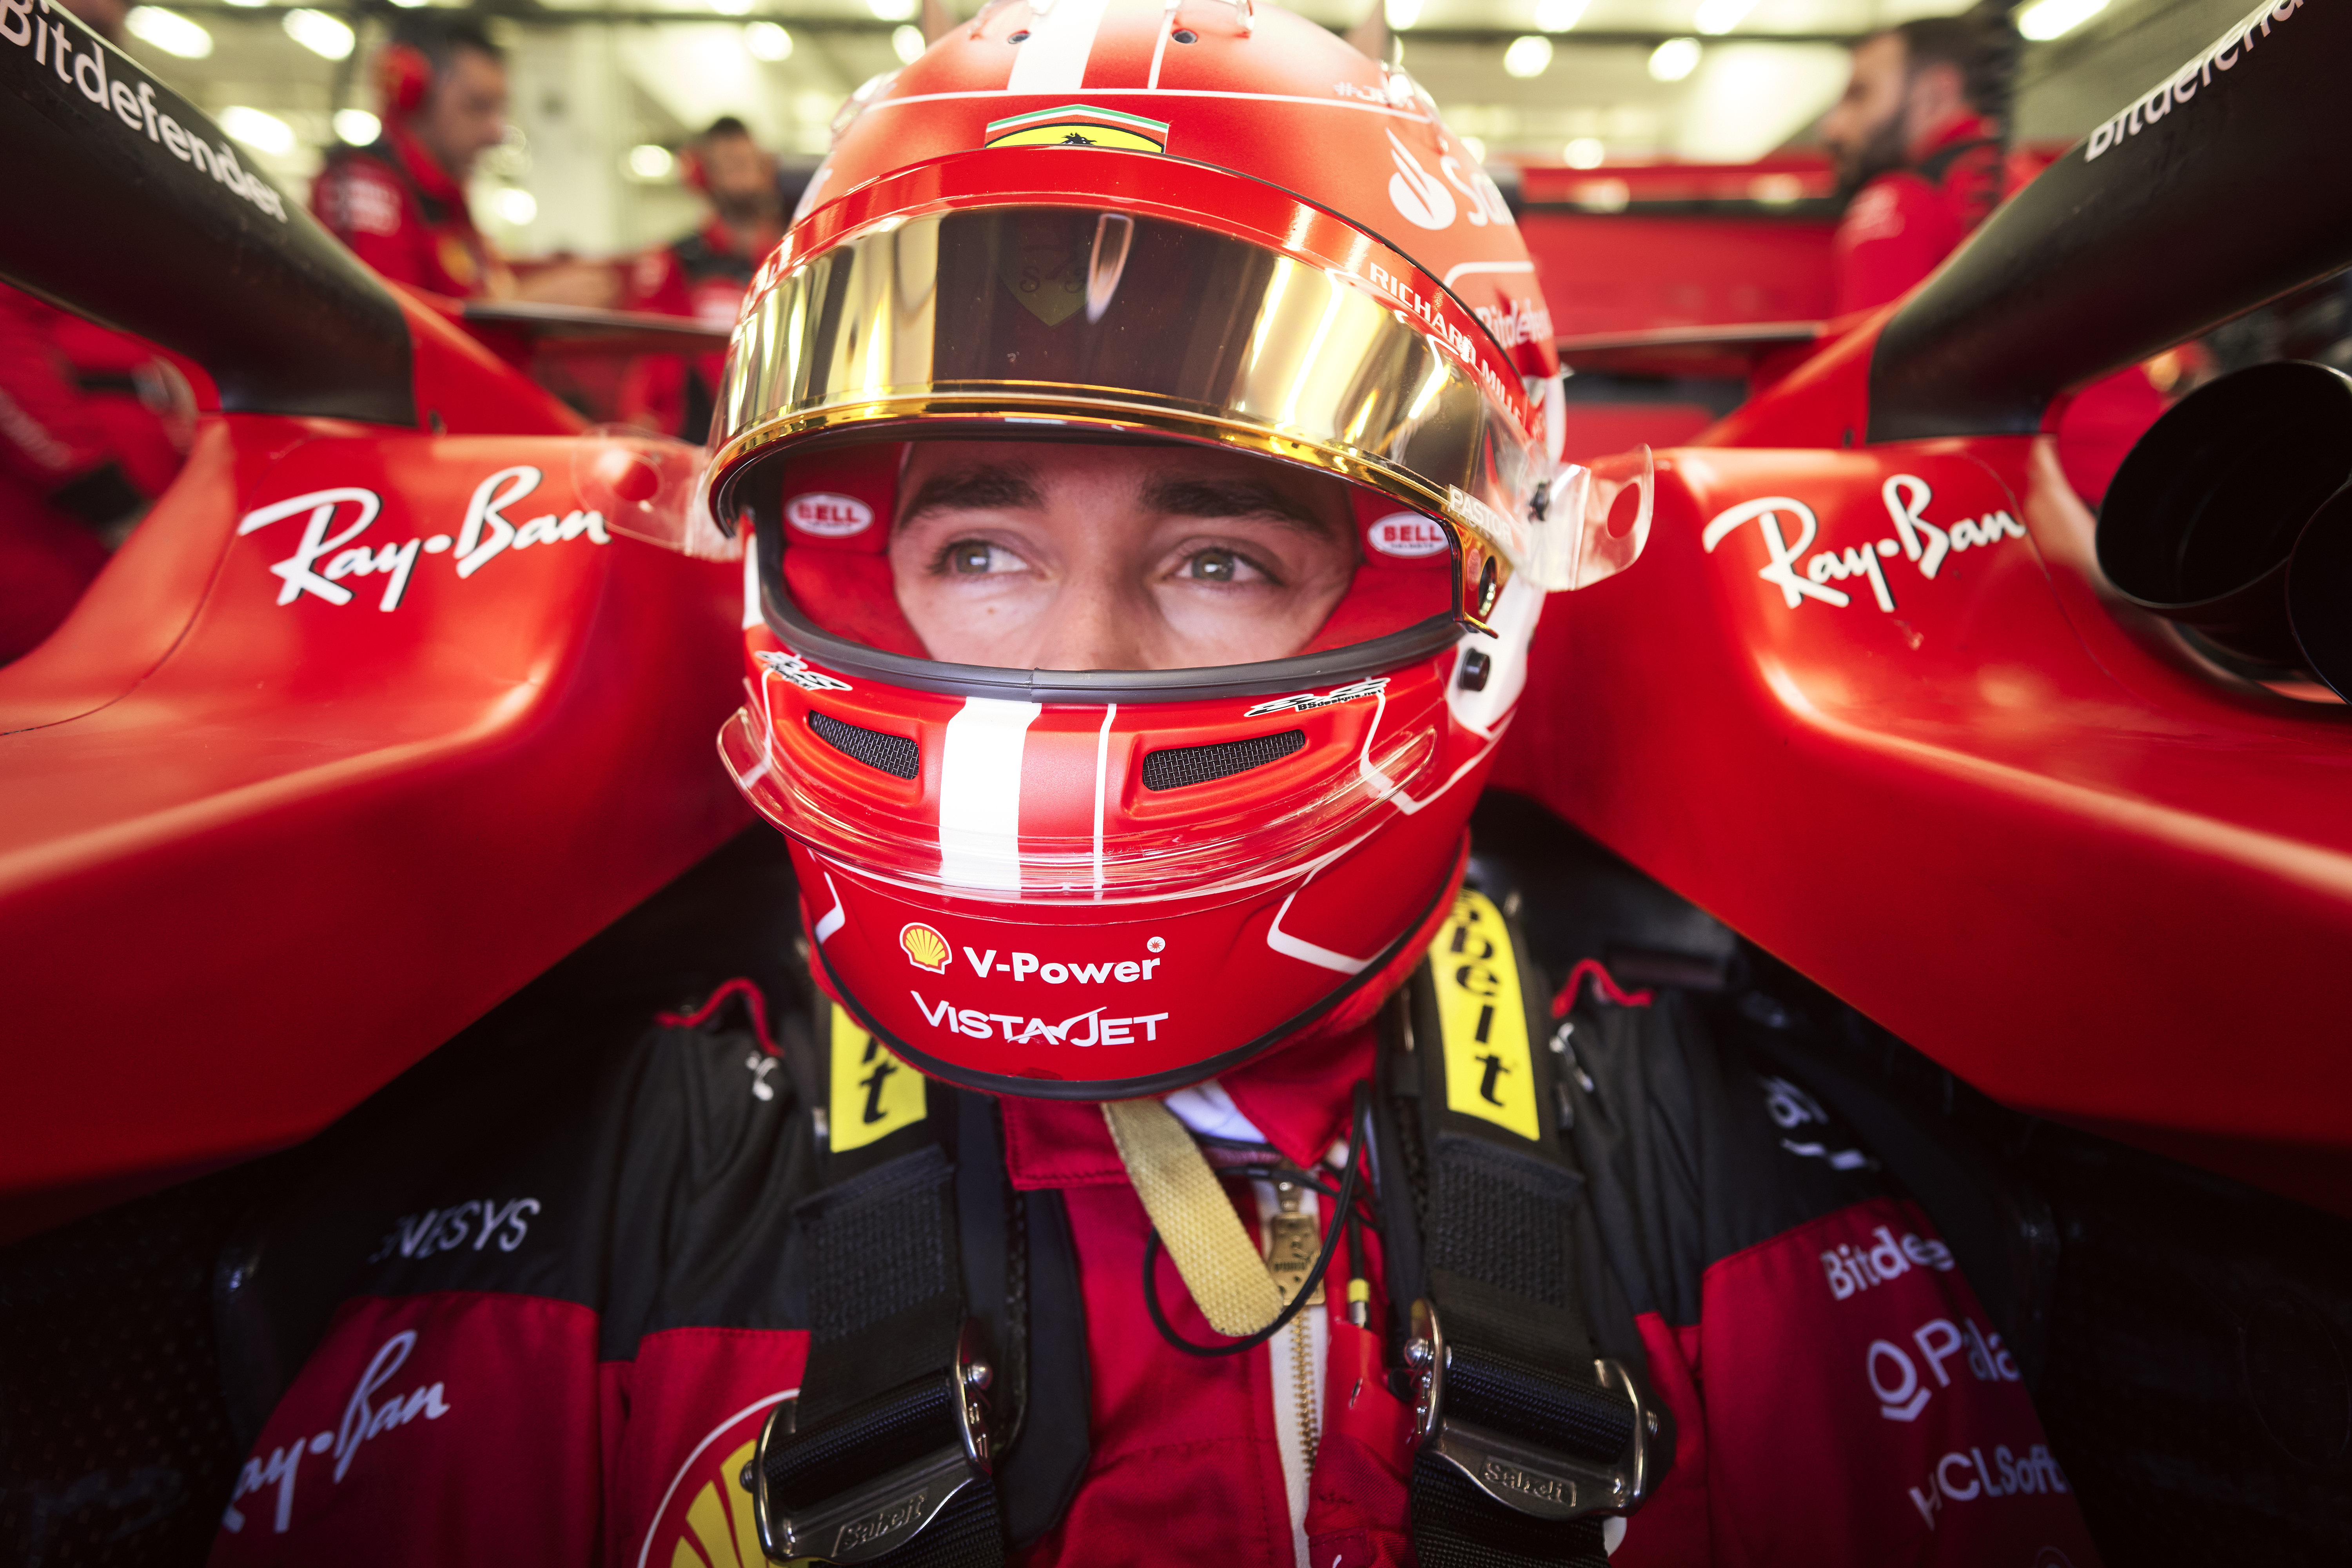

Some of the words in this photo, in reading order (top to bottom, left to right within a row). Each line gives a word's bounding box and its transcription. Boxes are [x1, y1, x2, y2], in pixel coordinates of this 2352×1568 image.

[0, 0, 288, 223] Bitdefender
[797, 502, 862, 523] BELL
[1450, 488, 1513, 546] PASTOR
[1383, 524, 1443, 542] BELL
[963, 946, 1161, 984] V-Power
